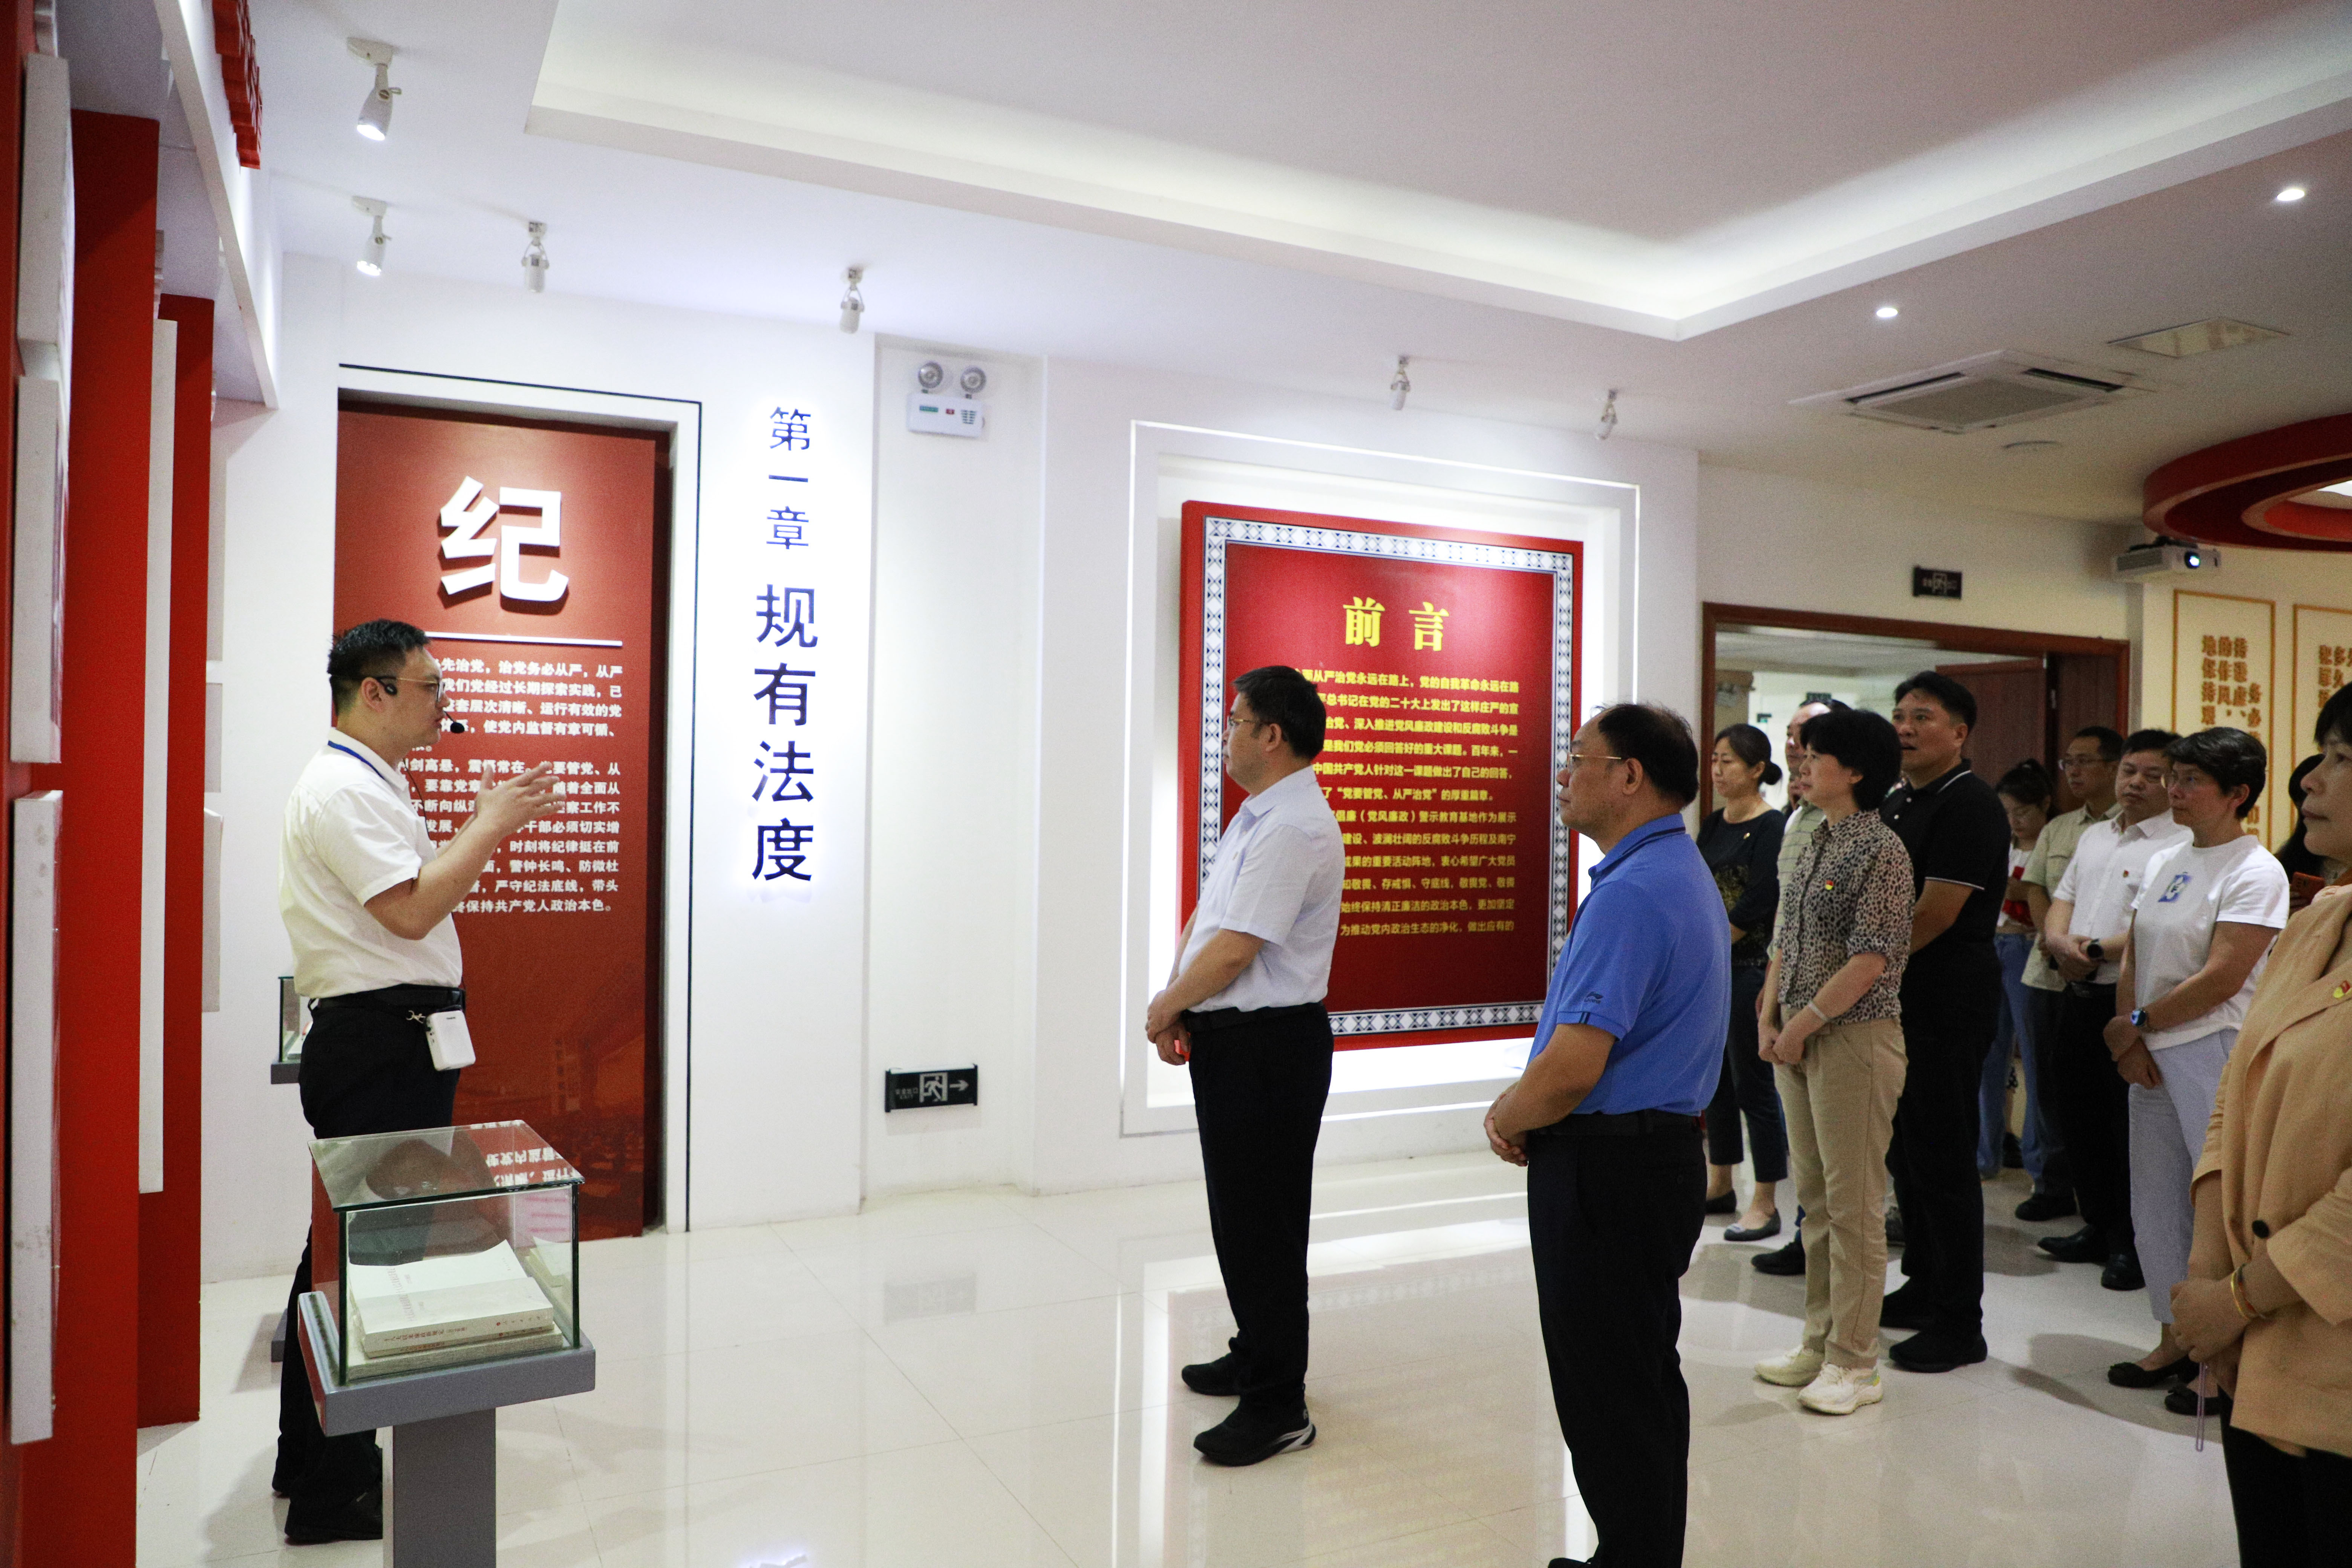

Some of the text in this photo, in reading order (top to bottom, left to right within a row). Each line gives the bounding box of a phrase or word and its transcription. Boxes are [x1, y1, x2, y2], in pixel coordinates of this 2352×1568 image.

[440, 475, 569, 602] 纪
[752, 407, 818, 881] 第一章 规有法度
[1343, 597, 1450, 651] 前言
[1295, 668, 1519, 693] 面从严治党永远在路上，党的自我革命永远在路
[1332, 810, 1516, 824] 倡廉（党风廉政）警示教育基地作为展示
